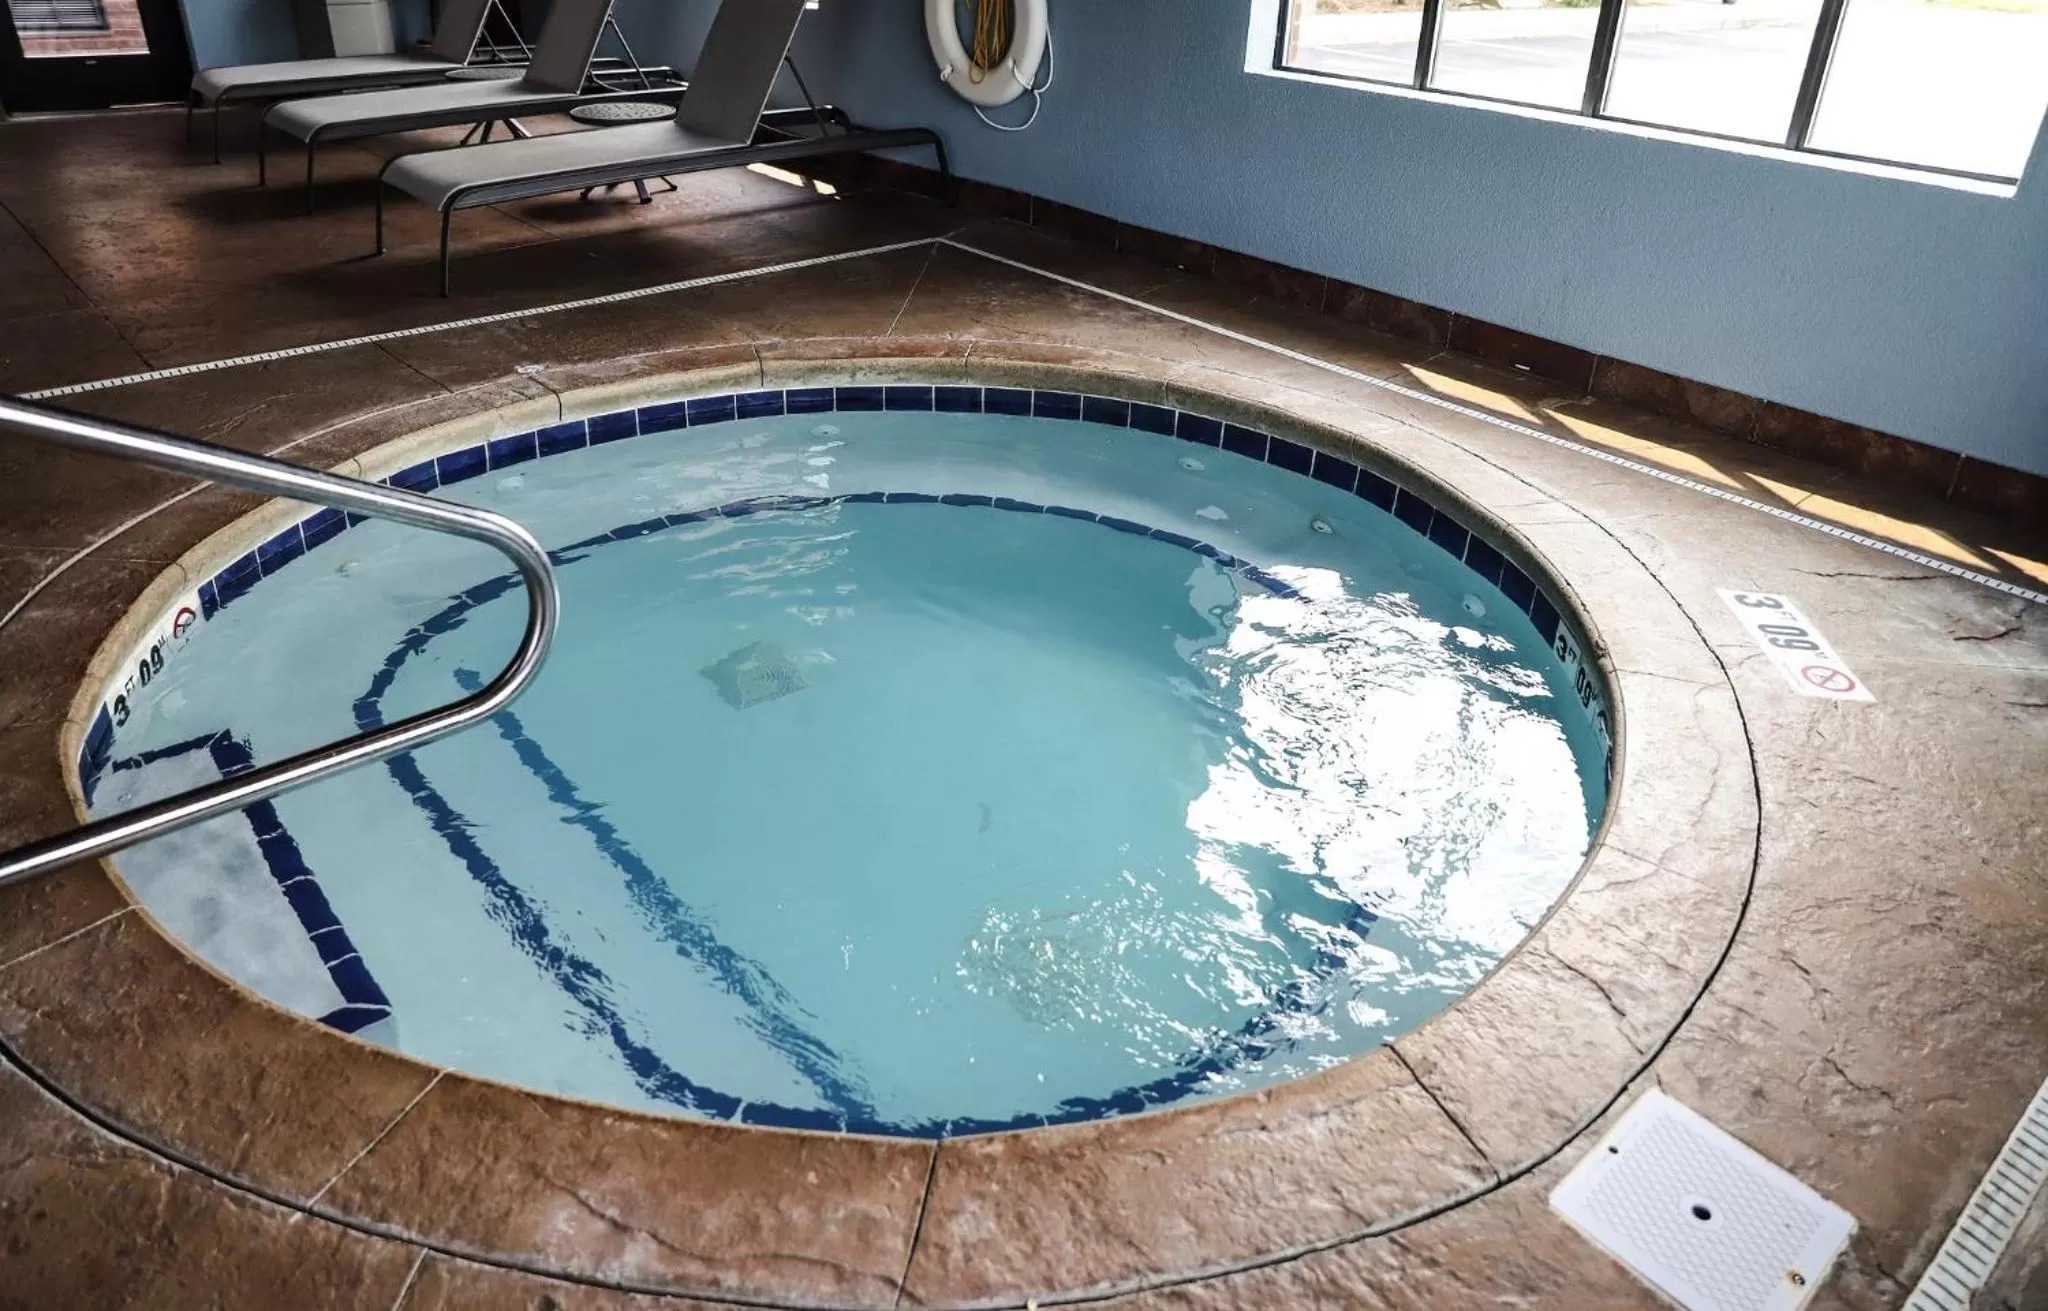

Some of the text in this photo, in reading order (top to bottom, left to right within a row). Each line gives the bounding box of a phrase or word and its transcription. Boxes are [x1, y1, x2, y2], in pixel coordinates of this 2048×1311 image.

[1734, 594, 1784, 609] 3
[1556, 634, 1567, 663] 3
[113, 694, 131, 728] 3
[124, 675, 136, 696] FT
